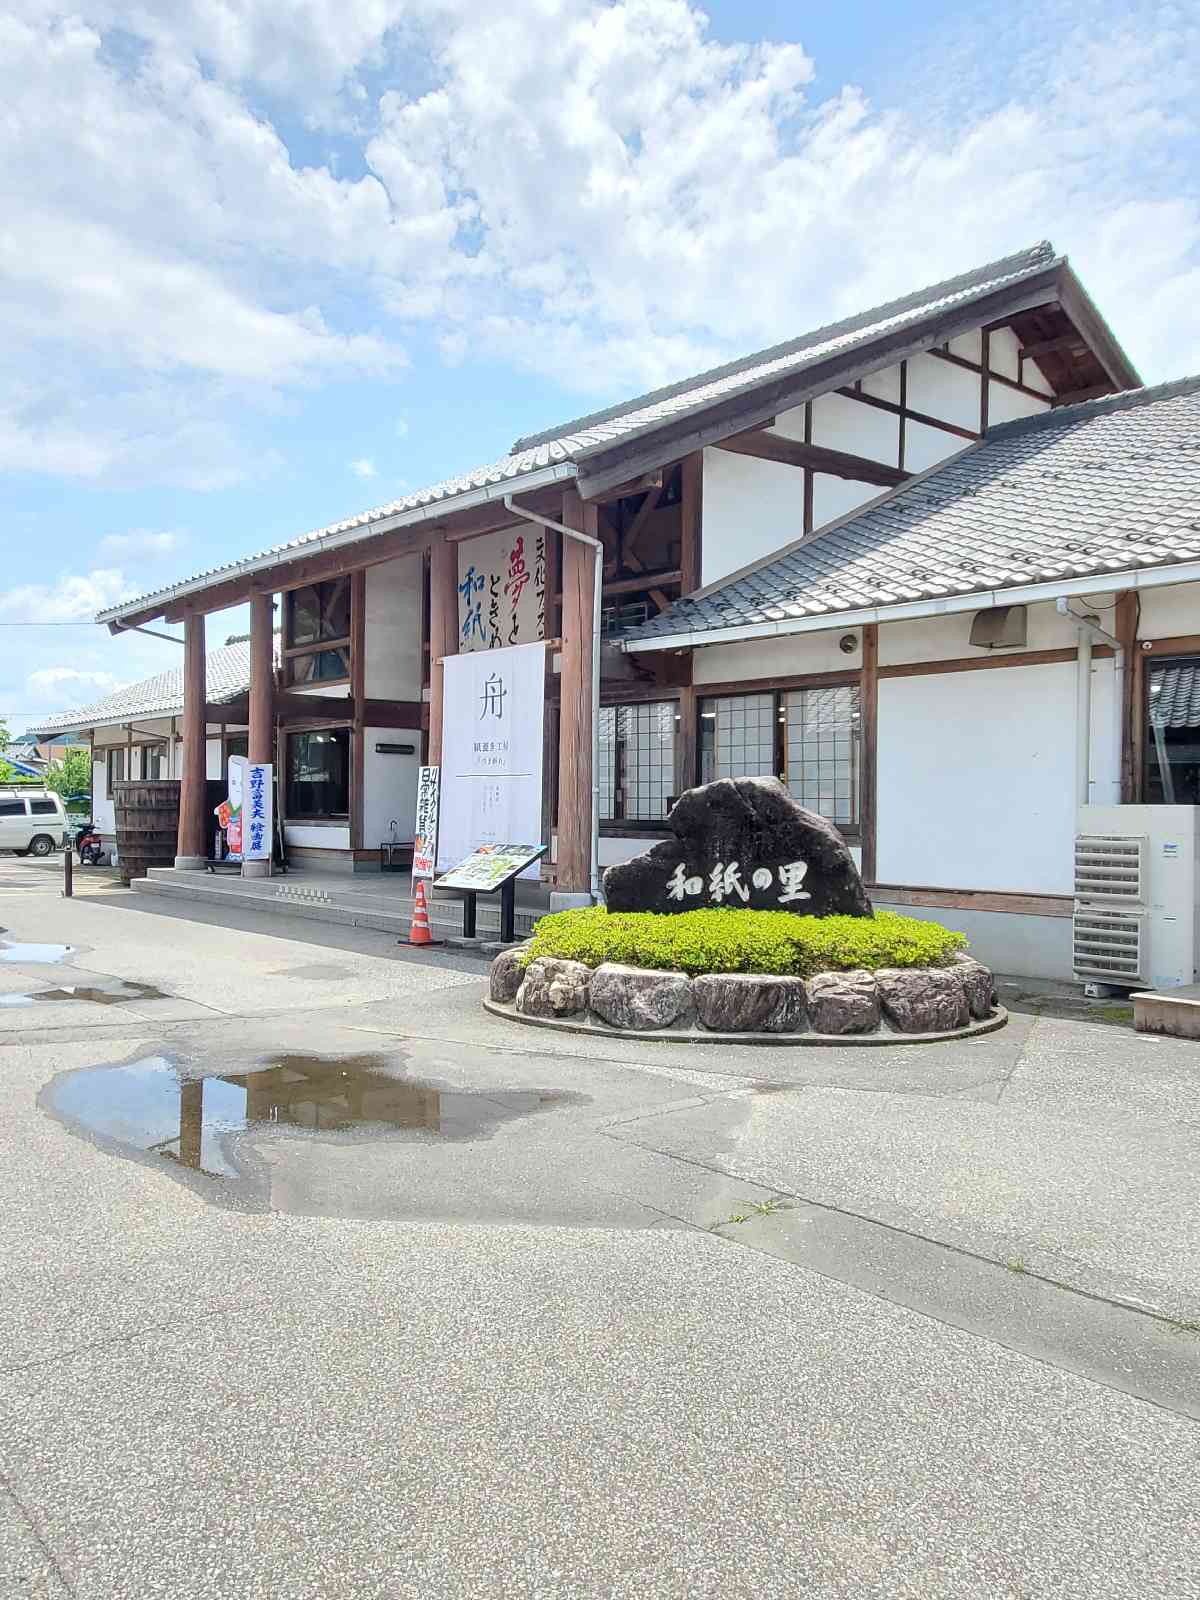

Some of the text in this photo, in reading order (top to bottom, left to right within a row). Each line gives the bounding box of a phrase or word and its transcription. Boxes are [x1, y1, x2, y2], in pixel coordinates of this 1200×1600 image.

[479, 672, 507, 720] 舟
[666, 861, 811, 903] 和紙の里
